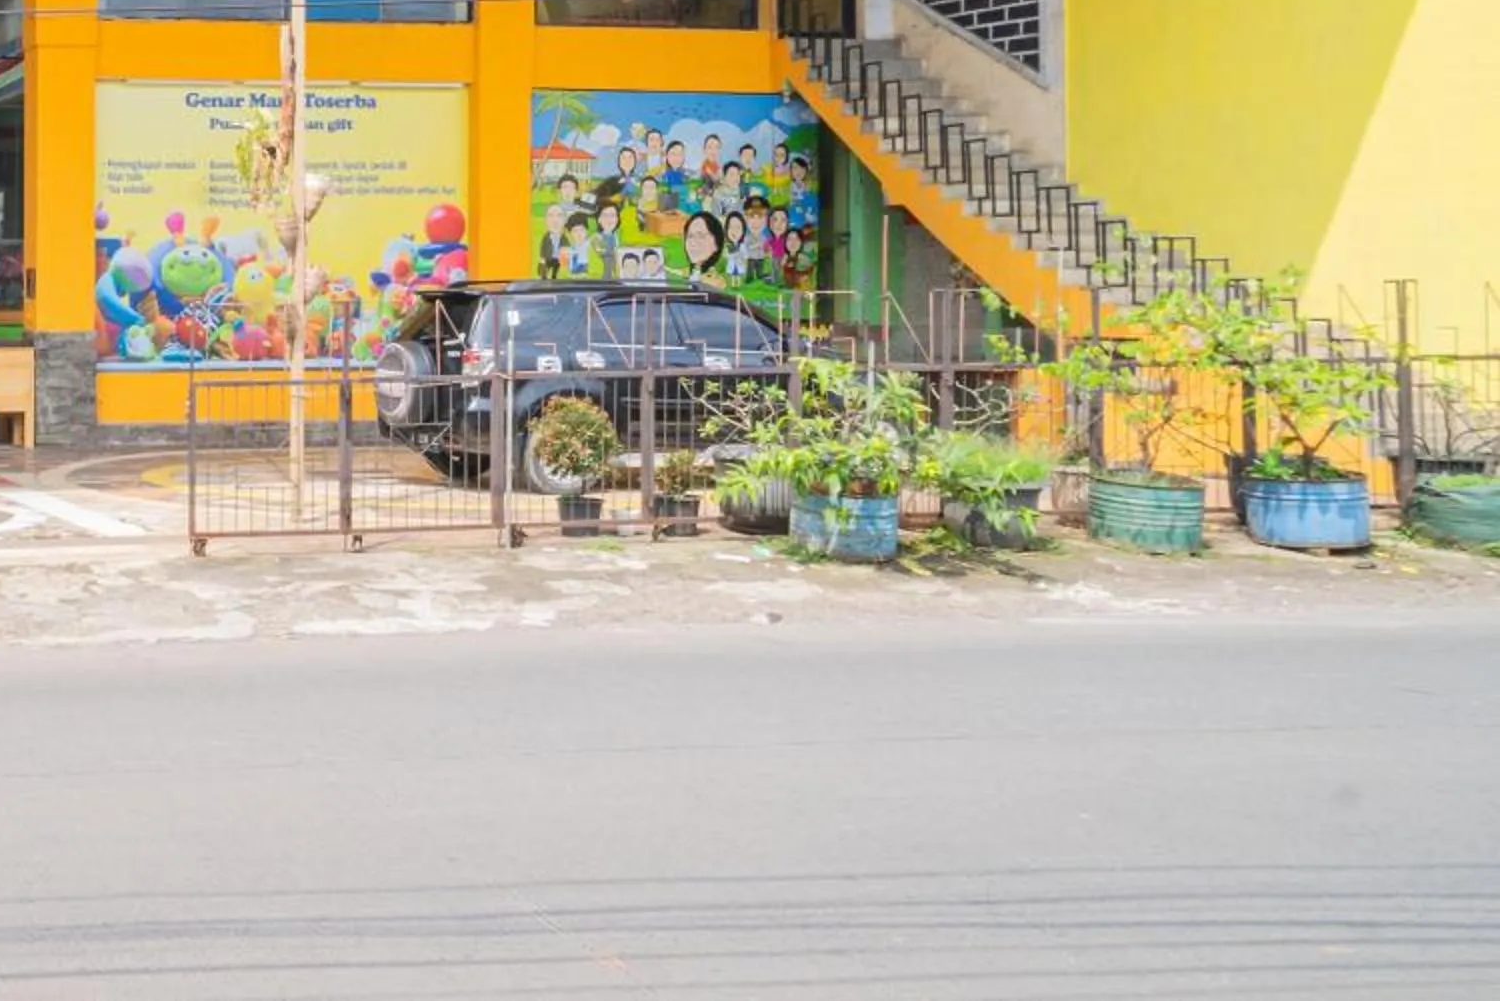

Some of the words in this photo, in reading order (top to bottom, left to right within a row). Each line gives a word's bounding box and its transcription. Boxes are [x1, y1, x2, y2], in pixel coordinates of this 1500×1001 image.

[185, 92, 245, 108] Genar
[249, 92, 283, 108] Ma
[304, 92, 378, 109] Toserba
[327, 118, 354, 133] gift
